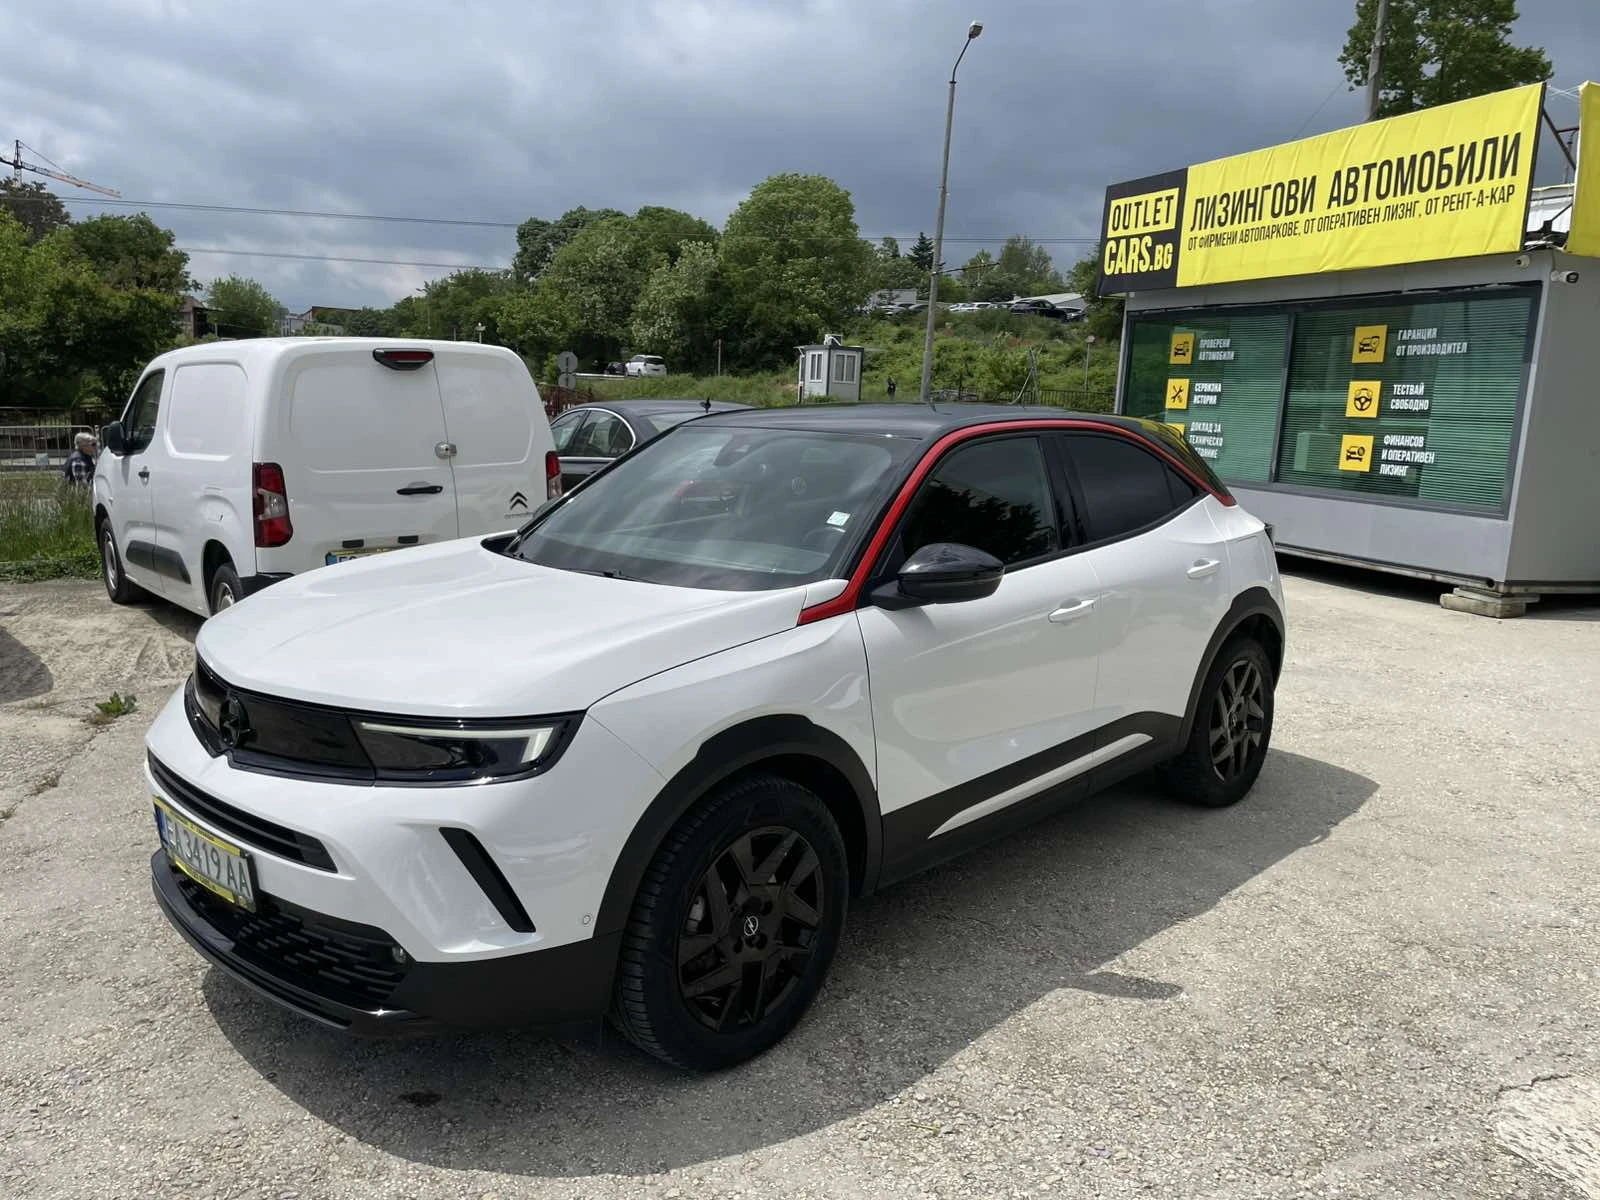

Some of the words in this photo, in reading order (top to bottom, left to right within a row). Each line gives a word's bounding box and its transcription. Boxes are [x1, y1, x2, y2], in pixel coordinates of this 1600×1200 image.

[1190, 175, 1317, 232] ЛИЗИНГОВИ
[1327, 132, 1521, 210] АВТОМОБИЛИ
[1112, 195, 1174, 231] OUTLET
[1188, 237, 1198, 251] ОТ
[1238, 220, 1301, 243] АВТОПАРКОВЕ,
[1304, 219, 1316, 234] ОТ
[1317, 207, 1381, 233] ОПЕРАТИВЕН
[1425, 197, 1440, 215] ОТ
[1442, 184, 1515, 213] РЕНТ-А-КАР
[1104, 235, 1174, 275] CARS.BG
[1398, 328, 1438, 341] ГАРАНЦИЯ
[1396, 345, 1406, 357] ОТ
[1392, 382, 1425, 396] ТЕСТВАЙ
[1390, 399, 1429, 411] СВОБОДНО
[1383, 434, 1425, 448] ФИНАНСОВ
[1388, 450, 1435, 464] ОПЕРАТИВЕН
[1379, 464, 1409, 477] ЛИЗИНГ
[226, 853, 252, 898] AA
